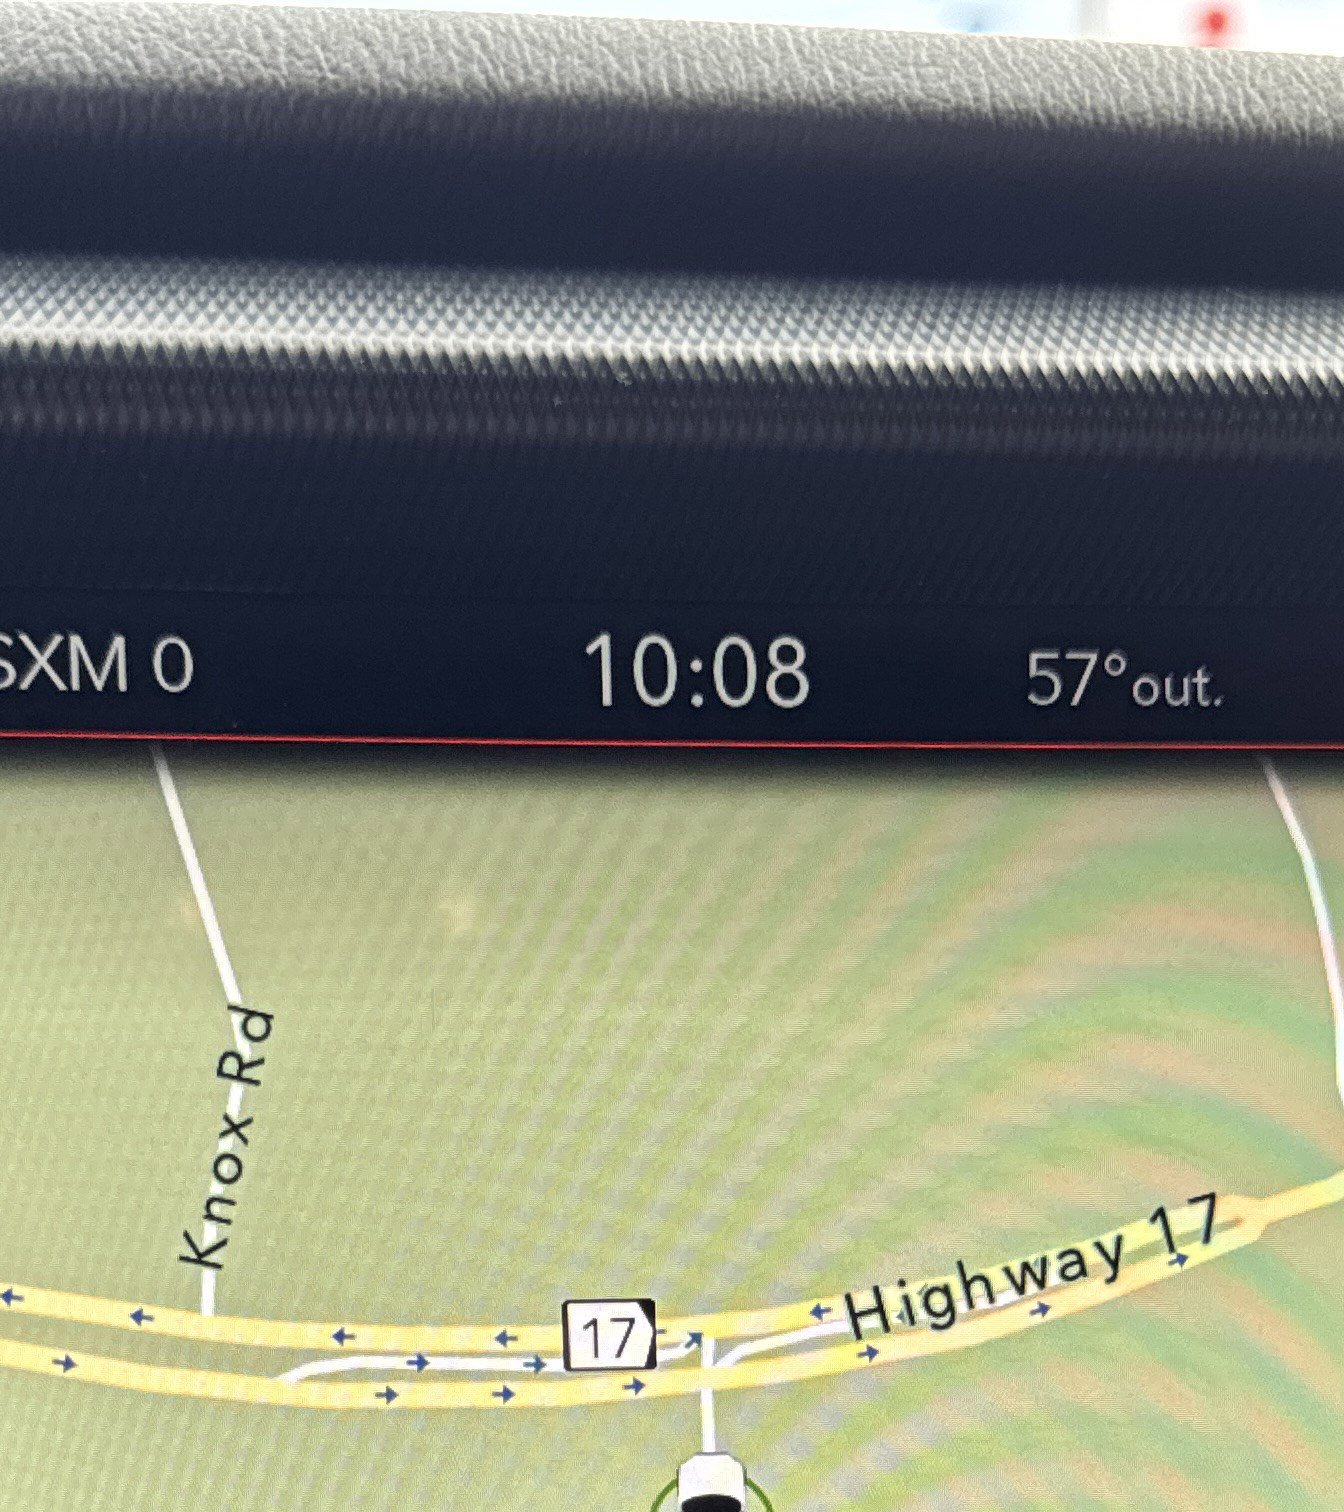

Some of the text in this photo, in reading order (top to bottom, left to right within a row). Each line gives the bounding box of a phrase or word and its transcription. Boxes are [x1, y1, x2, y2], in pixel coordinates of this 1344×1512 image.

[150, 634, 195, 693] 0
[584, 632, 812, 710] 10:08
[178, 1004, 274, 1268] Knox Rd
[843, 1192, 1221, 1341] Highway 17
[580, 1316, 637, 1360] 17
